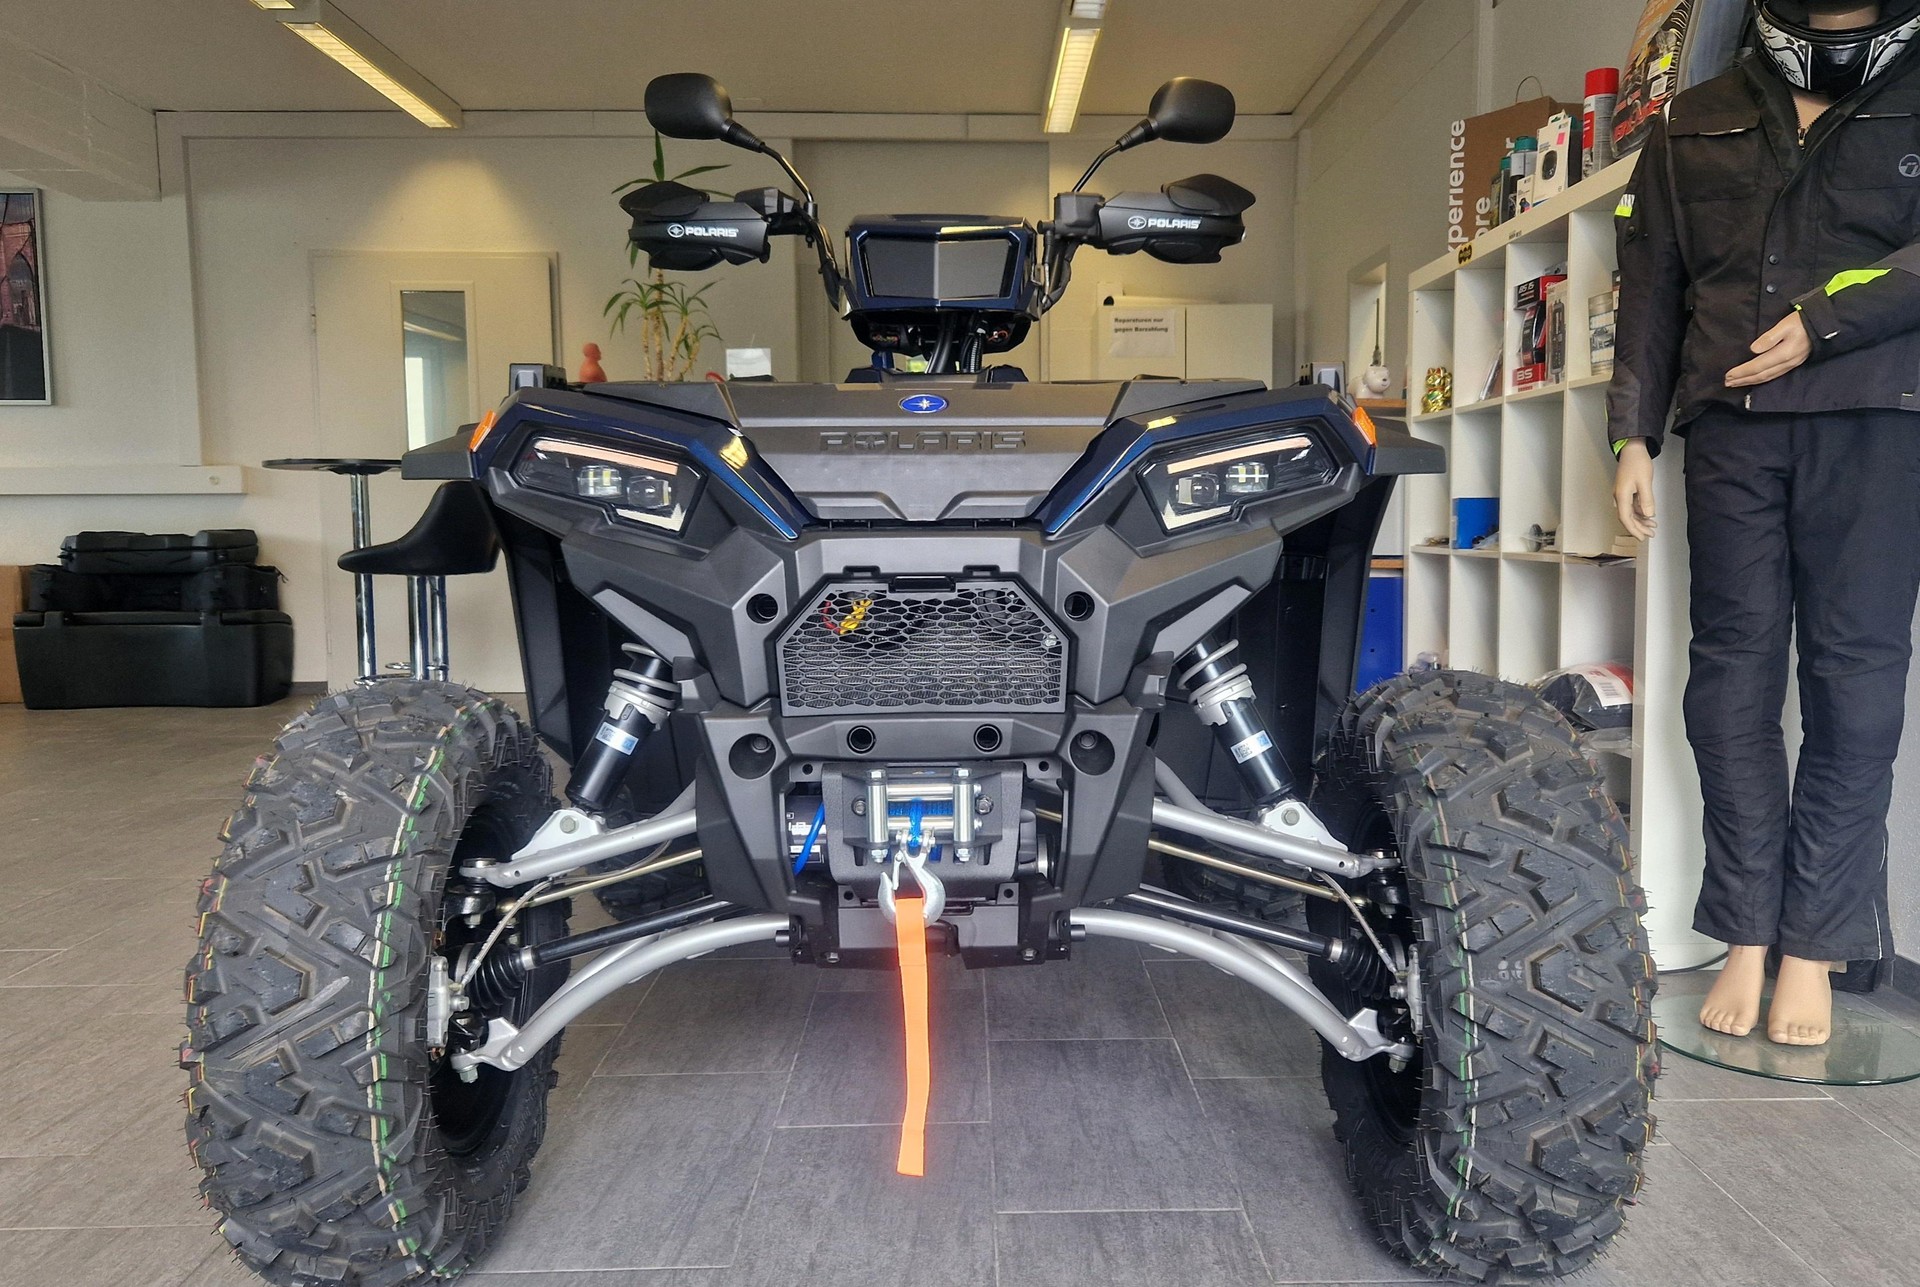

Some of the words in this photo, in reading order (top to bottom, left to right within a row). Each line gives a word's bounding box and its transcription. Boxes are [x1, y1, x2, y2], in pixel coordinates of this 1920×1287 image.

[1148, 218, 1201, 229] POLARIS
[685, 226, 737, 238] POLARIS
[820, 431, 1026, 450] POLARIS
